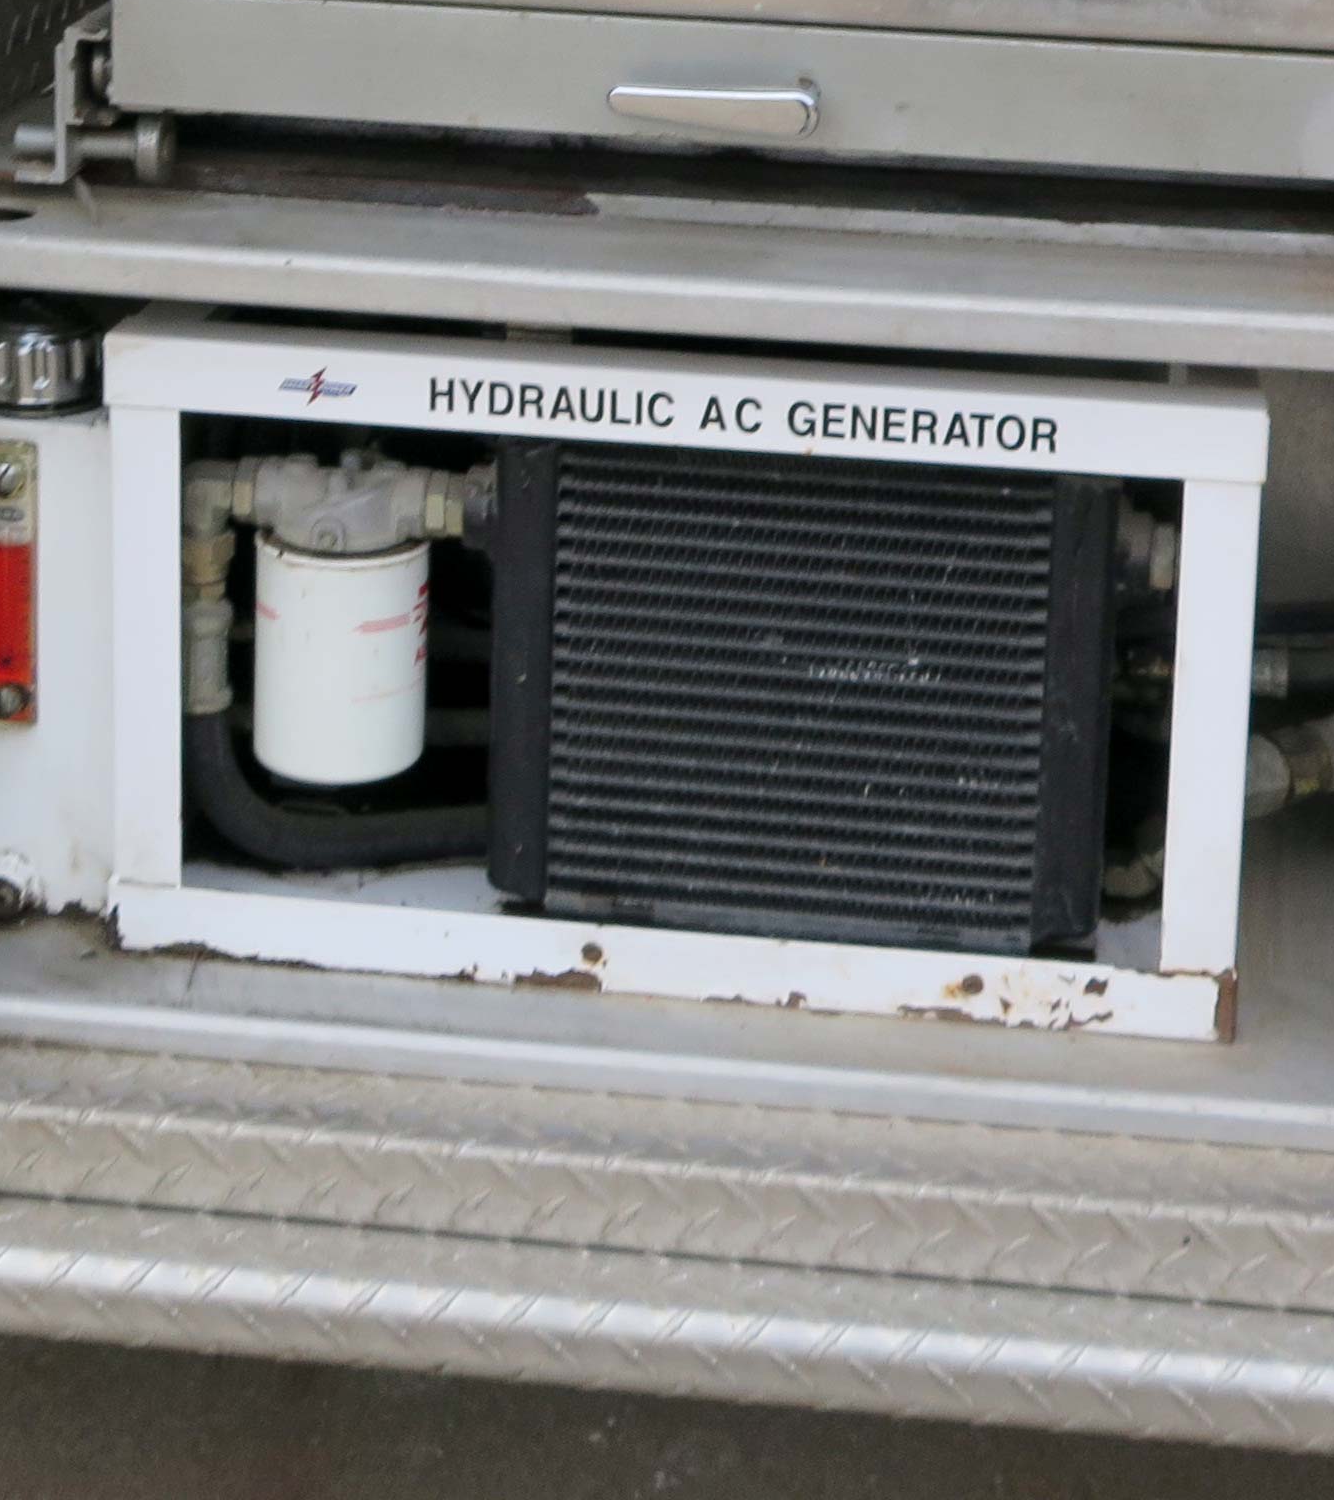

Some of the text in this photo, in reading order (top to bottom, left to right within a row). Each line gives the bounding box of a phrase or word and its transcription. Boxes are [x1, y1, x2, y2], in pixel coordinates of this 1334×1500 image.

[429, 377, 1058, 453] HYDRAULIC AC GENERATOR
